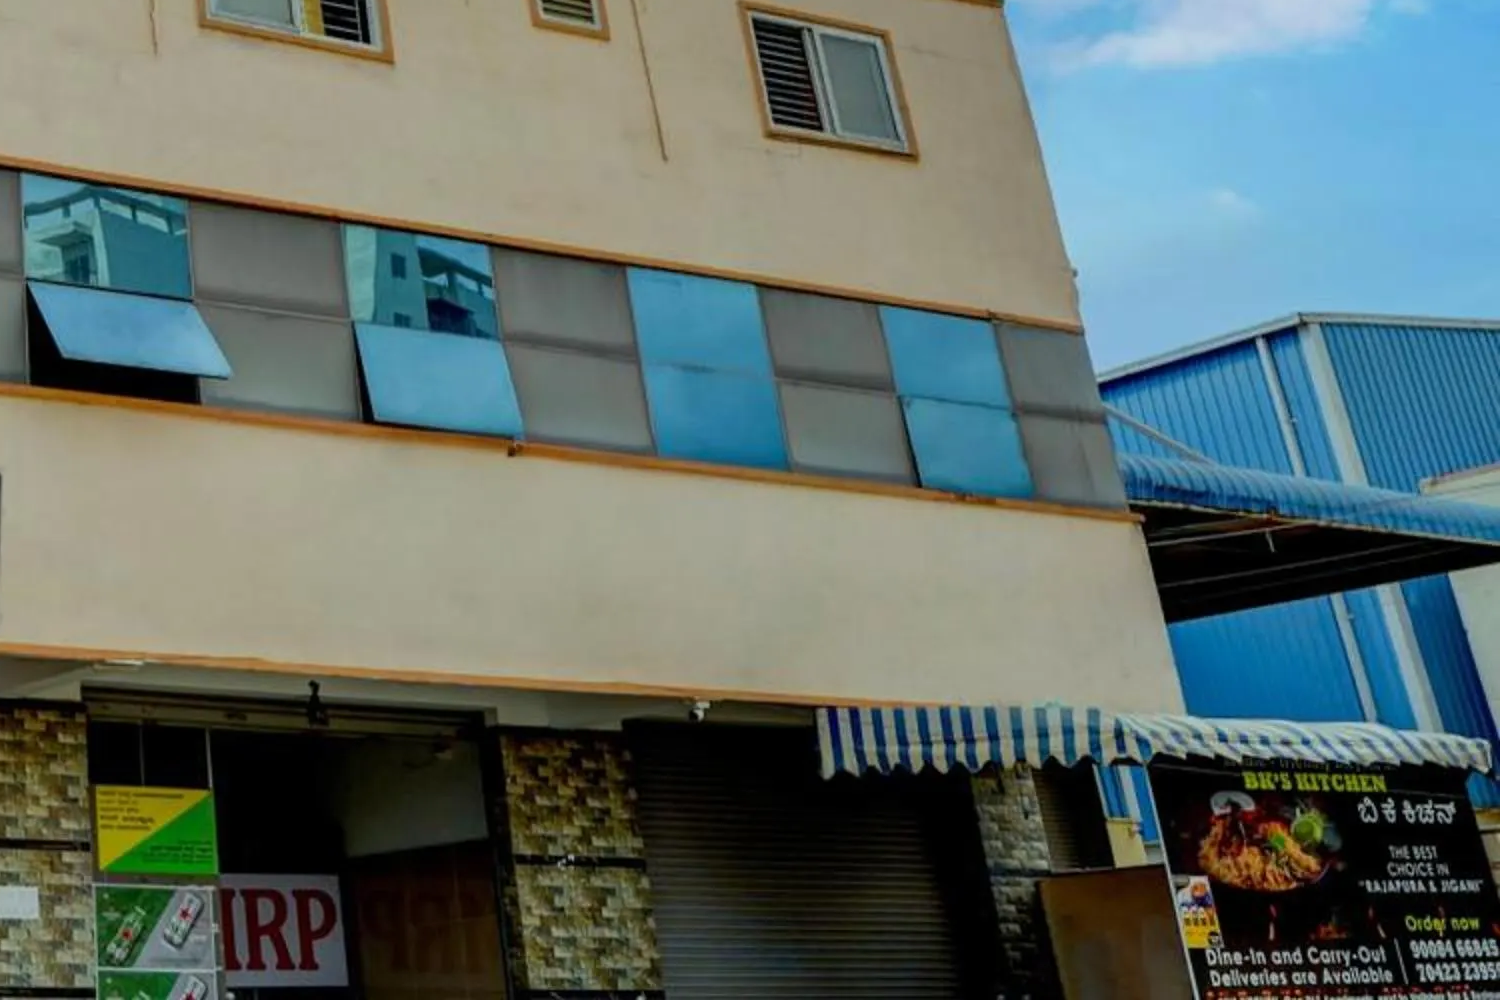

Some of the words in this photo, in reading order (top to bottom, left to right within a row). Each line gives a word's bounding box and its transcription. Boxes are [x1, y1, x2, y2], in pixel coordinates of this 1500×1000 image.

[1243, 771, 1291, 790] BK'S
[1294, 771, 1388, 793] KITCHEN
[1389, 845, 1410, 859] THE
[1413, 845, 1438, 859] BEST
[1387, 862, 1435, 877] CHOICE
[1437, 863, 1450, 876] IN
[1404, 914, 1446, 932] Order
[1450, 917, 1481, 931] now
[1206, 948, 1268, 966] Dine-In
[1272, 947, 1303, 964] and
[1307, 947, 1387, 968] Carry-Out
[1210, 968, 1288, 987] Deliveries
[1291, 971, 1317, 985] are
[1321, 967, 1393, 985] Available
